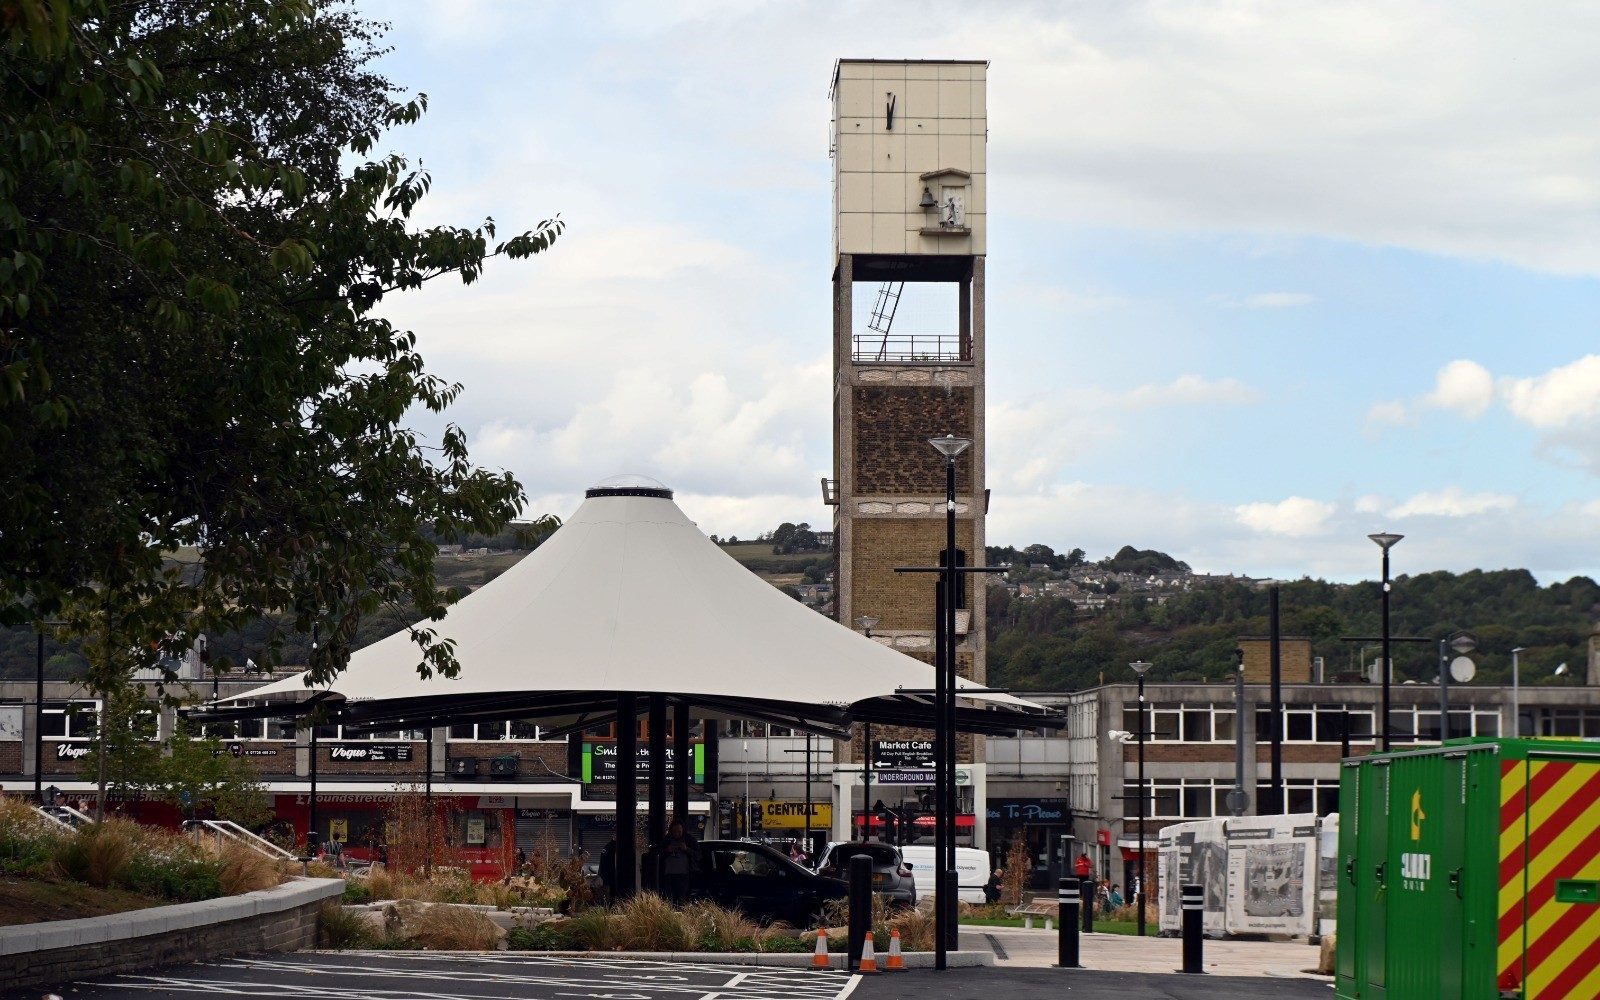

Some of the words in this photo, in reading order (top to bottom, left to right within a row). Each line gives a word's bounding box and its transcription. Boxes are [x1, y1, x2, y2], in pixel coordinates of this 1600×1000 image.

[880, 741, 909, 749] Market
[912, 741, 932, 749] Cafe
[331, 747, 367, 759] Vogue
[880, 773, 924, 781] UNDERGROUND
[767, 803, 818, 816] CENTRAL
[1003, 804, 1020, 818] To
[1022, 804, 1062, 819] Please
